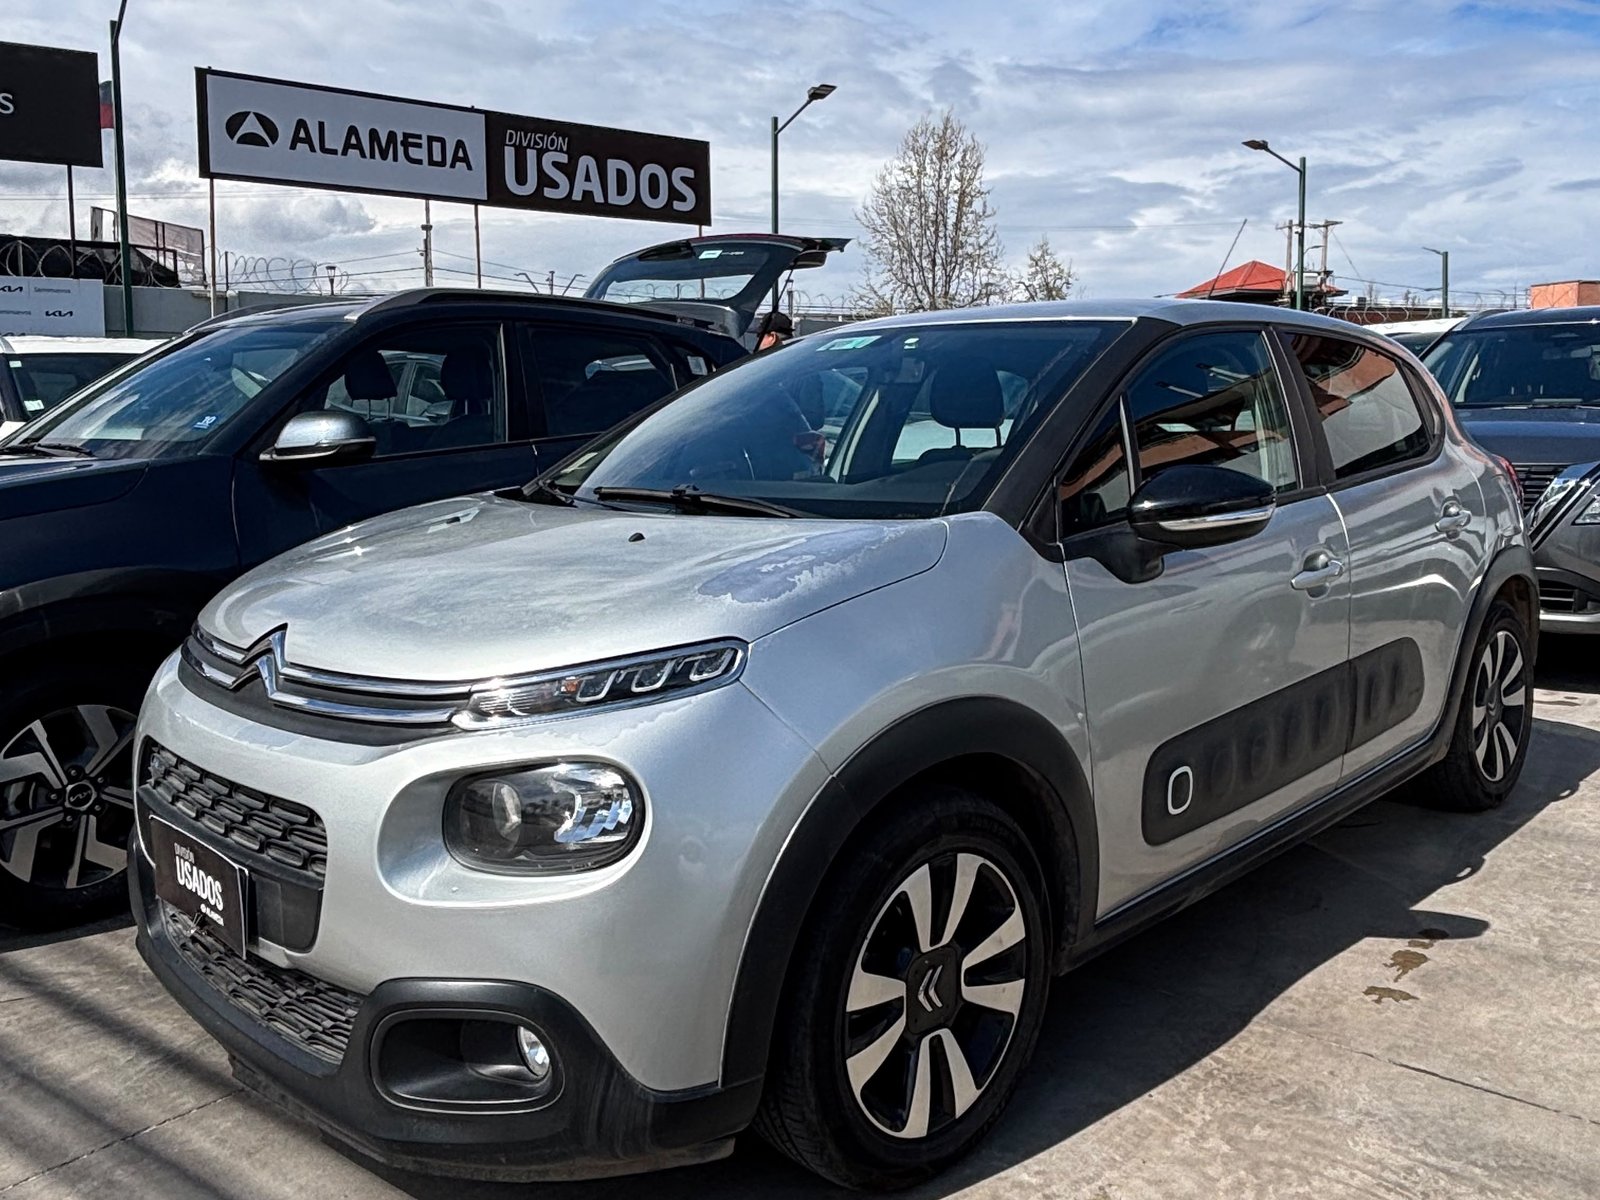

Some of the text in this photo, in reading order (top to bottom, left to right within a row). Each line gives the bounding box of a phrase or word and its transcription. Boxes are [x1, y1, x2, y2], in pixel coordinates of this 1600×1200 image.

[289, 118, 473, 171] ALAMEDA
[505, 129, 568, 152] DIVISIÓN
[504, 146, 696, 212] USADOS
[176, 856, 224, 912] USADOS
